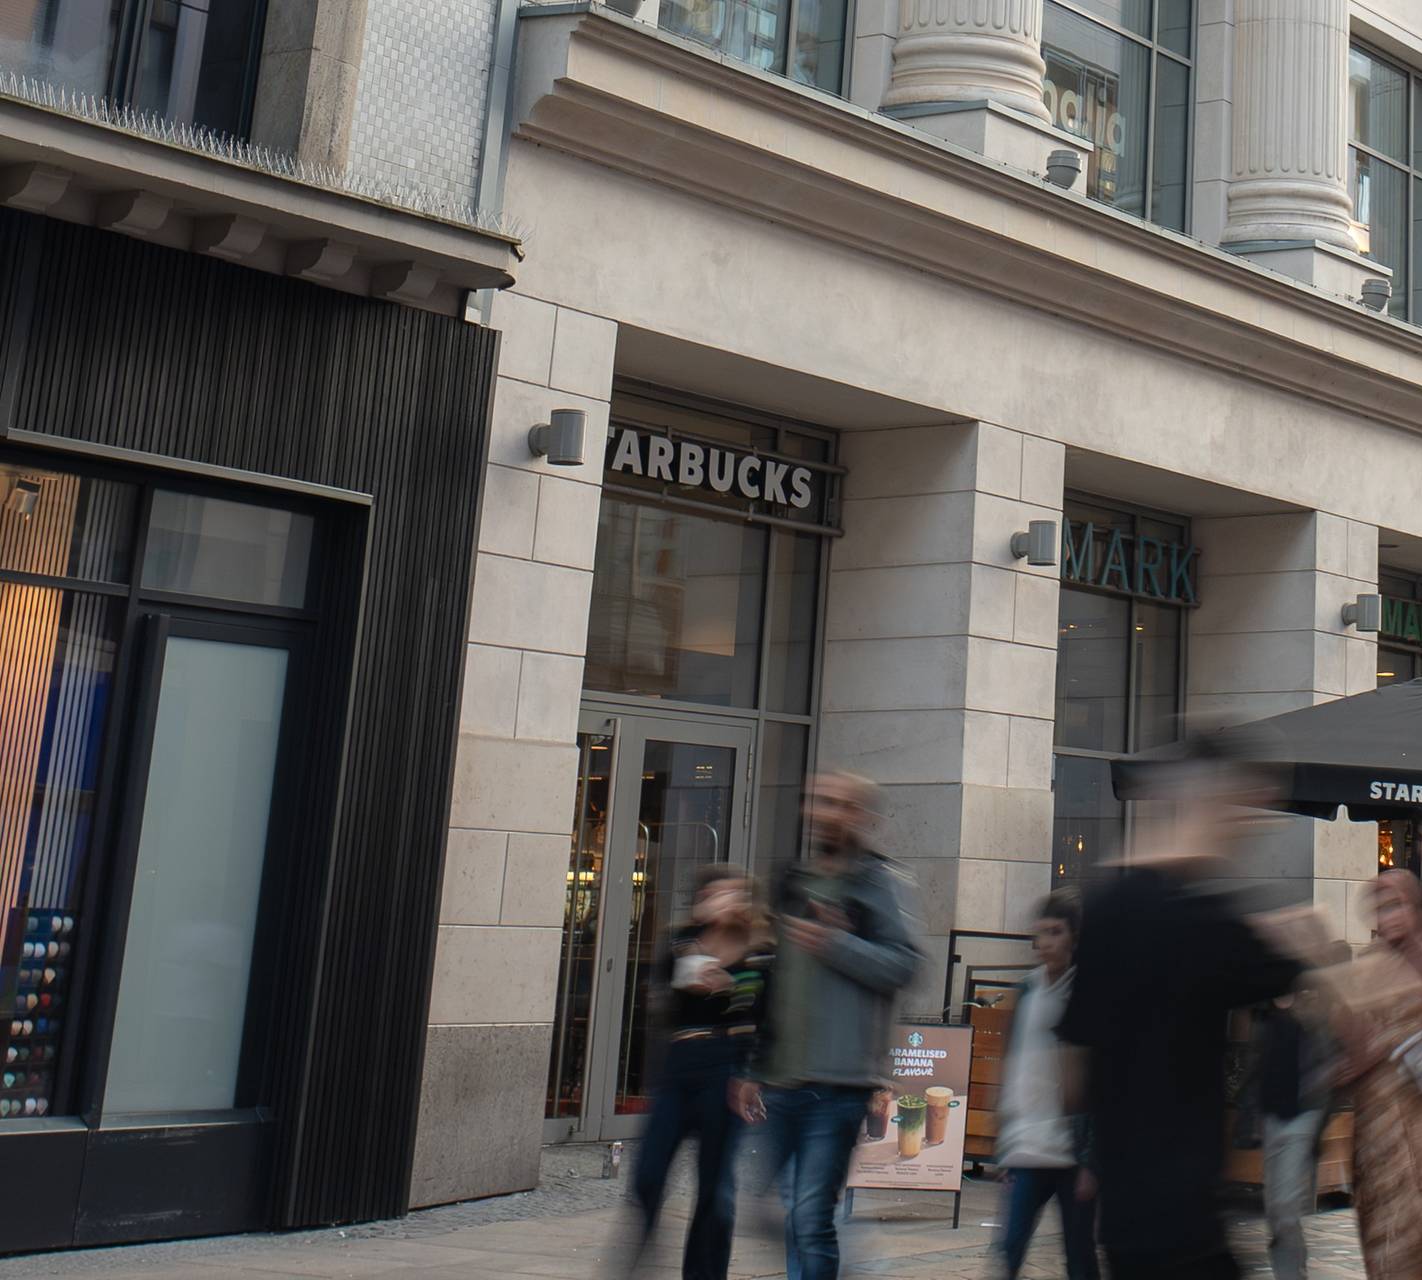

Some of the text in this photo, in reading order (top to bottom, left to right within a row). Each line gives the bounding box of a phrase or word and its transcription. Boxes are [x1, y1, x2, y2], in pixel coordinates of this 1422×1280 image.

[607, 426, 813, 509] ARBUCKS
[894, 1057, 934, 1068] BANANA
[892, 1067, 934, 1077] FLAVOUR
